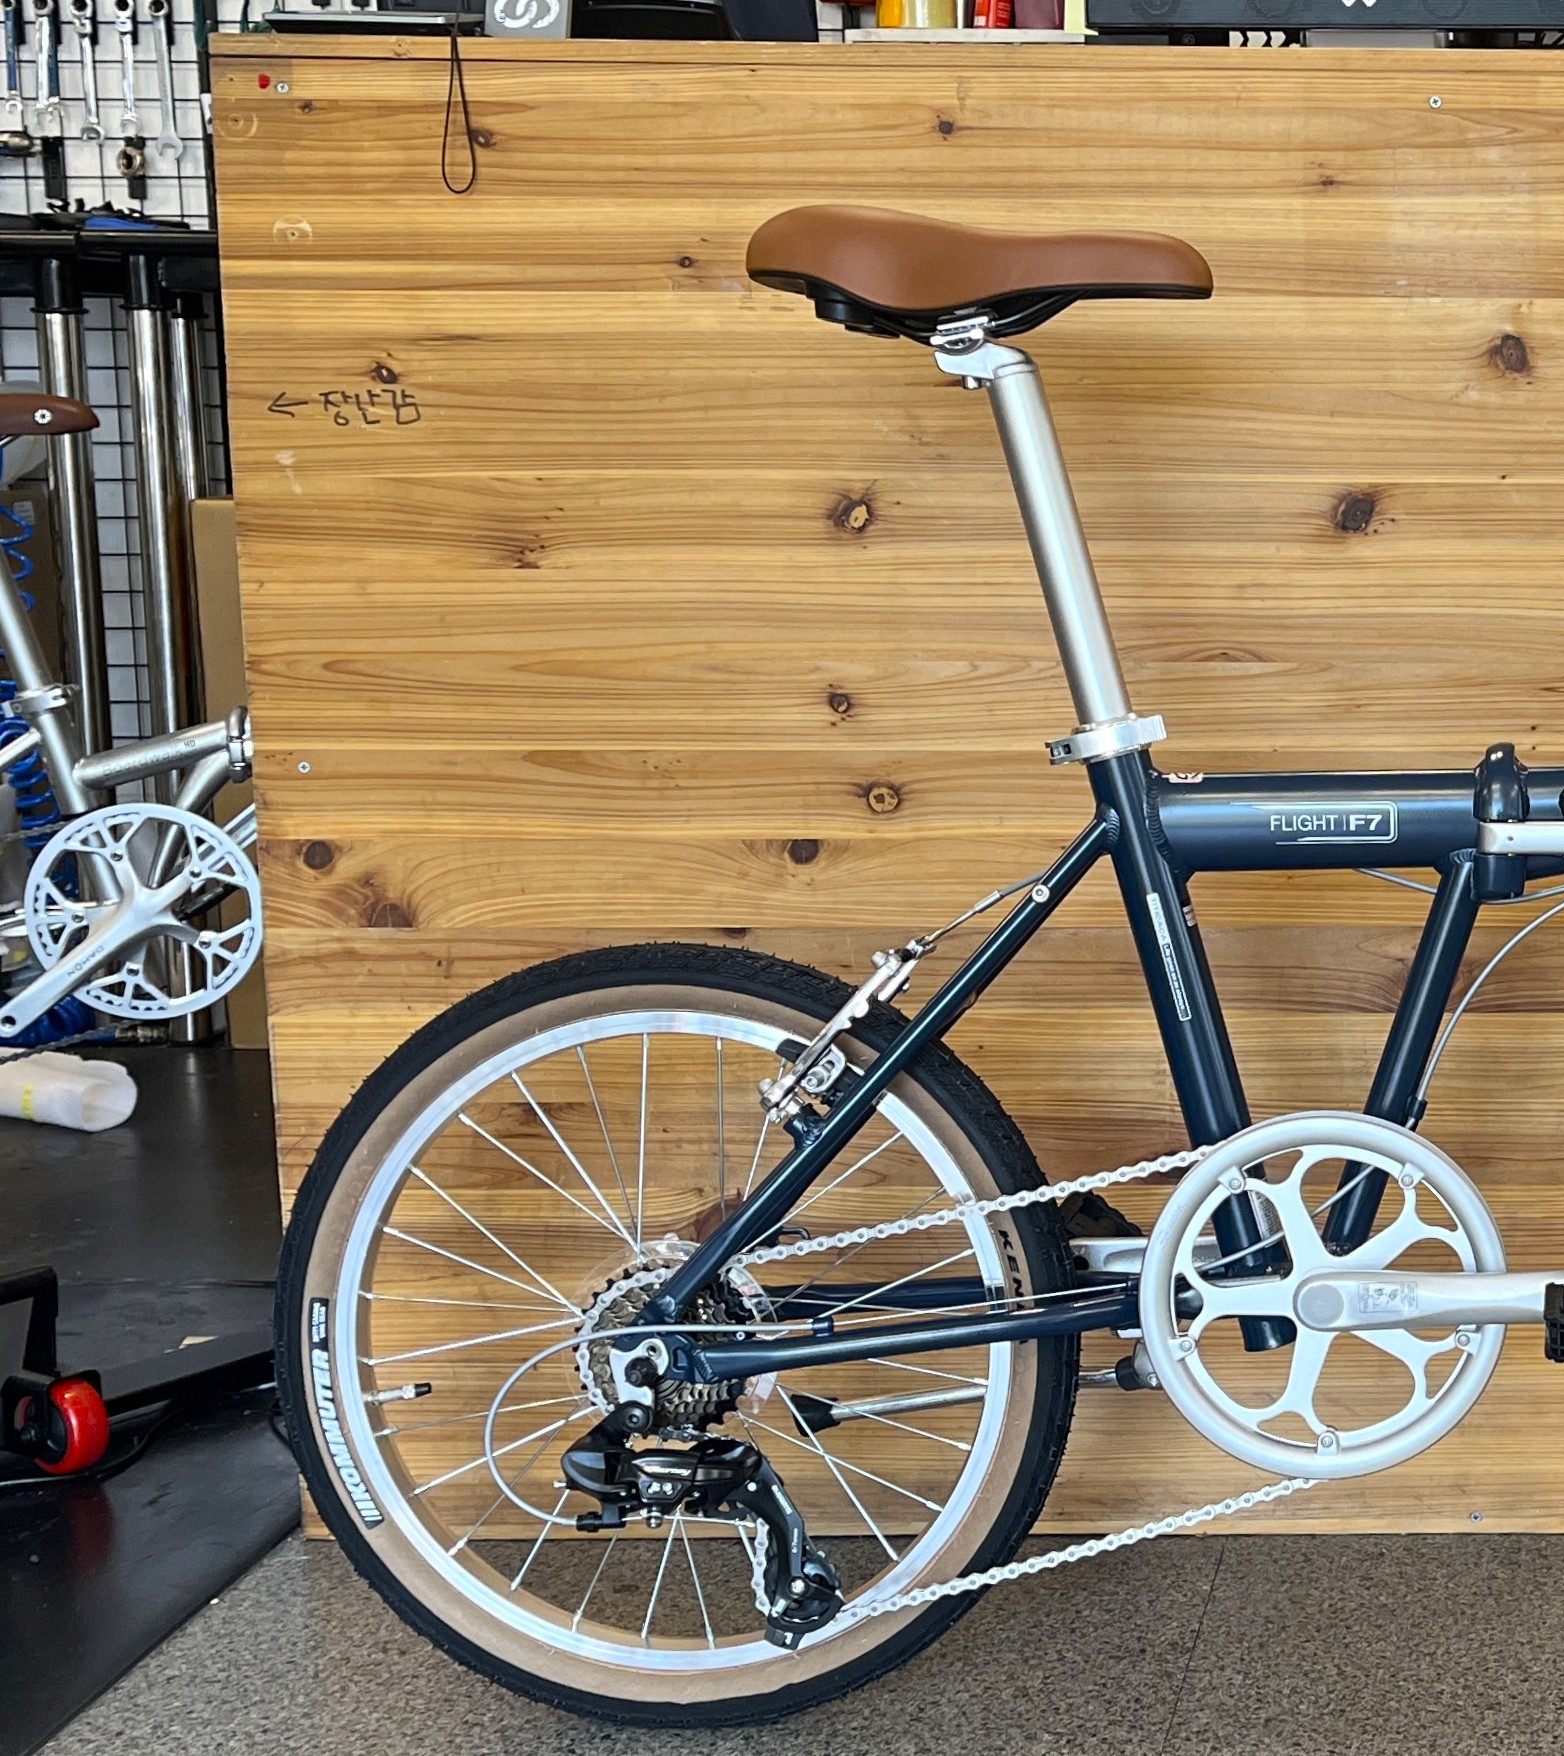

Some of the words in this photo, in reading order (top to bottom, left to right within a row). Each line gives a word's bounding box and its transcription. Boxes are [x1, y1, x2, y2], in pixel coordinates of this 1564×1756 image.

[318, 388, 421, 426] 장난감
[1270, 814, 1339, 832] FLIGHT
[1349, 814, 1383, 831] F7
[311, 1348, 371, 1501] KOMMUTER
